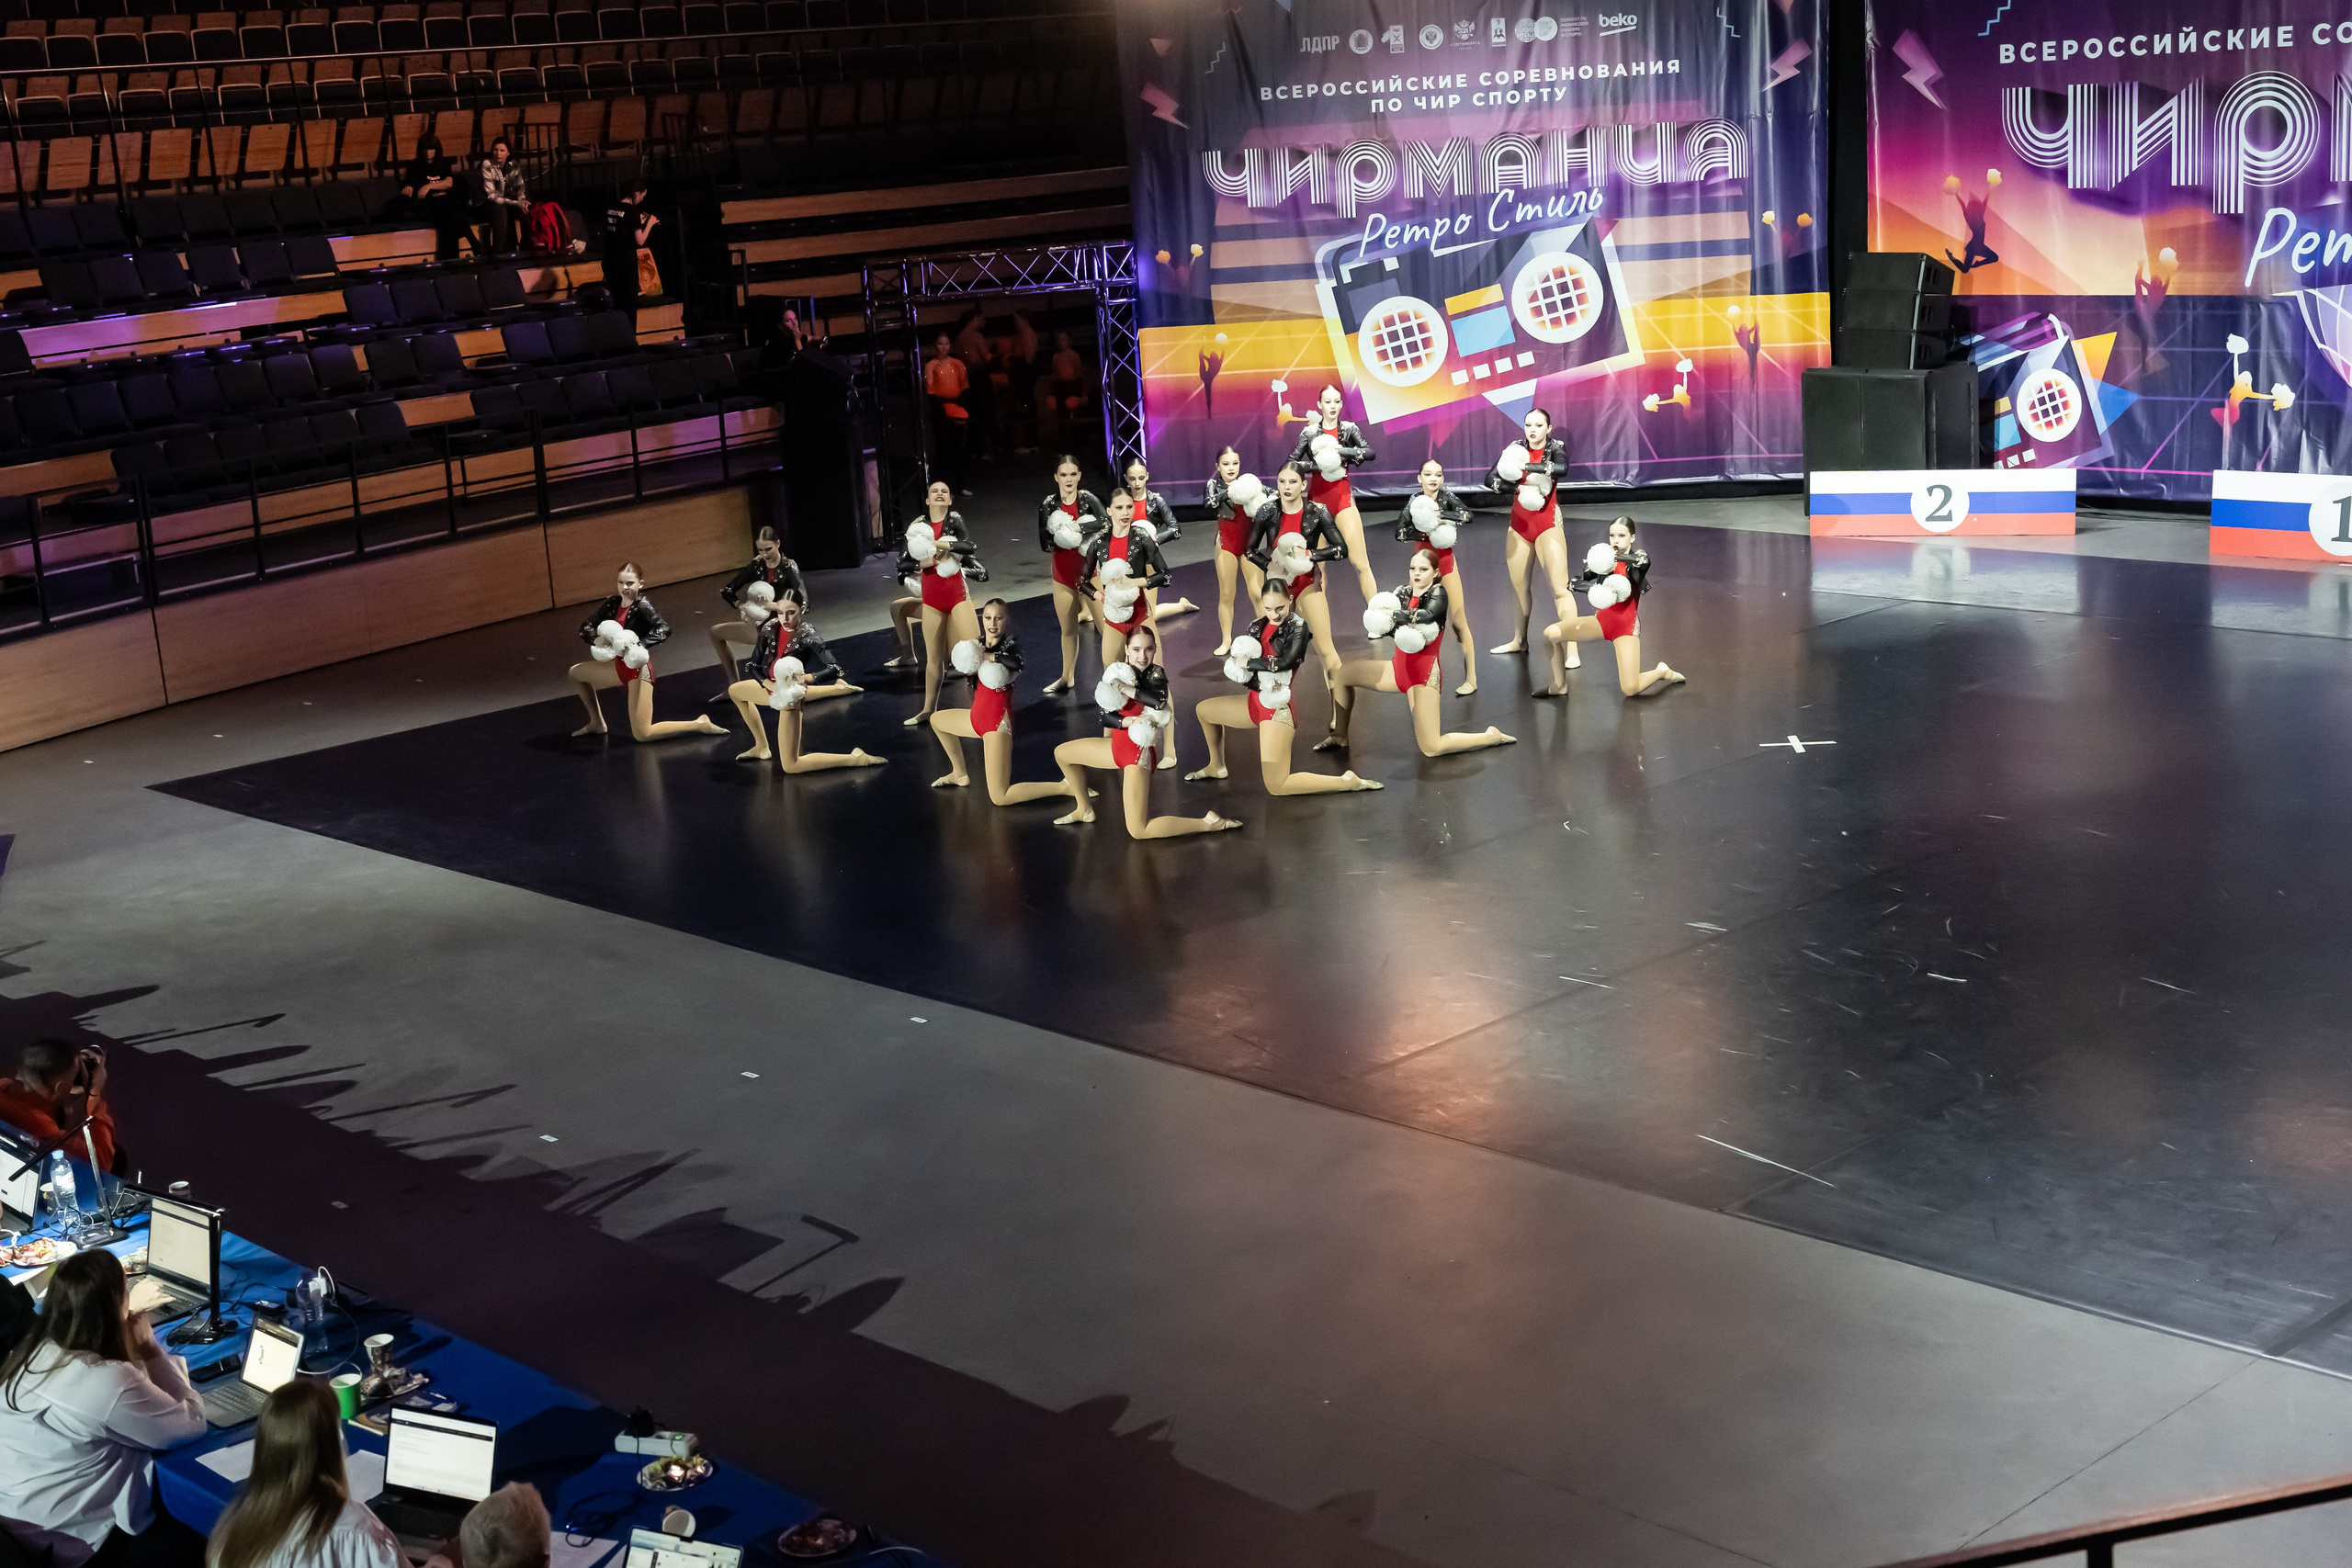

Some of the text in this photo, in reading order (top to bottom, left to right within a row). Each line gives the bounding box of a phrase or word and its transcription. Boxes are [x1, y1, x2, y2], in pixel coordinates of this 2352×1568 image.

[1599, 13, 1638, 28] beko
[1300, 35, 1340, 54] ЛДПР
[1999, 25, 2294, 64] ВСЕРОССИЙСКИЕ
[1260, 59, 1680, 101] ВСЕРОССИЙСКИЕ СОРЕВНОВАНИЯ
[1370, 86, 1567, 113] ПО ЧИР СПОРТУ
[1359, 187, 1604, 258] Ретро Стиль
[1925, 484, 1953, 522] 2
[2331, 495, 2352, 543] 1
